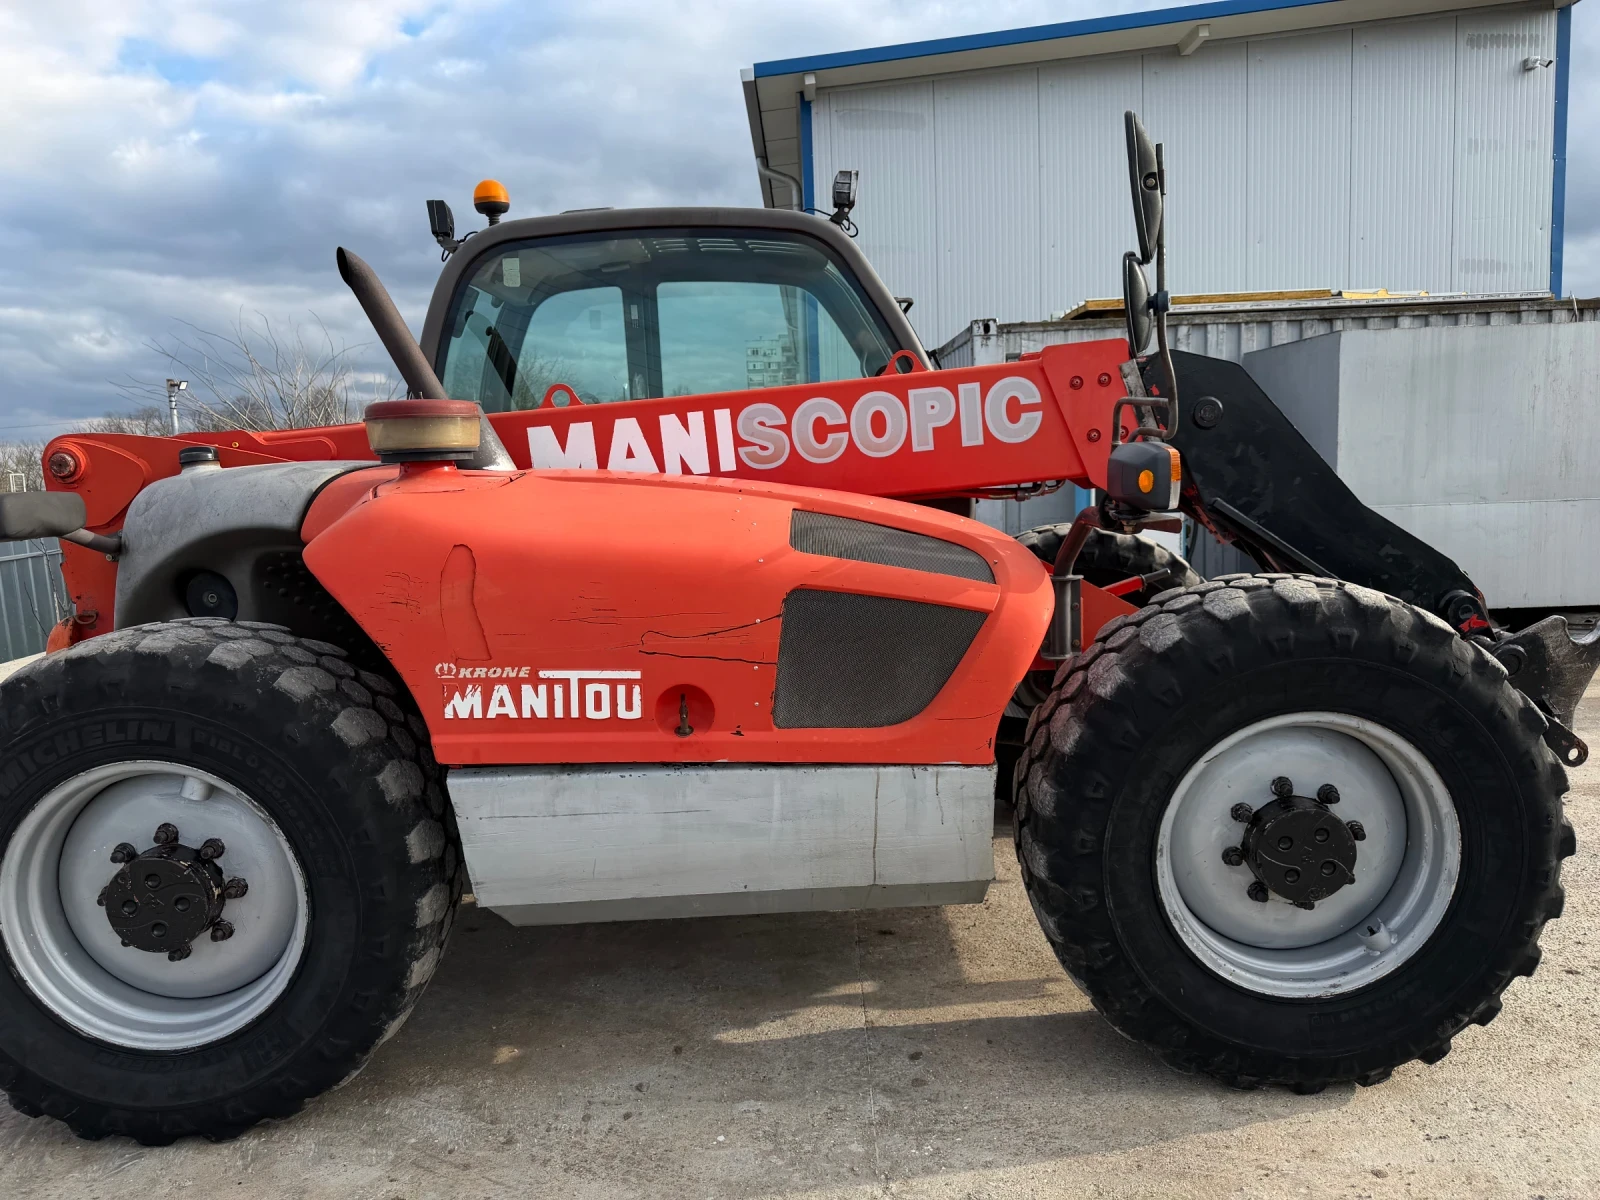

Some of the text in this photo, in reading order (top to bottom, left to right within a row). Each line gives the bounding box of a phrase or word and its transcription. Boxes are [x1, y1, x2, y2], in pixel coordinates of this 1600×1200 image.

[526, 376, 1043, 475] MANISCOPIC
[443, 669, 642, 720] MANITOU
[458, 666, 531, 679] KRONE
[0, 719, 173, 798] MICHELIN
